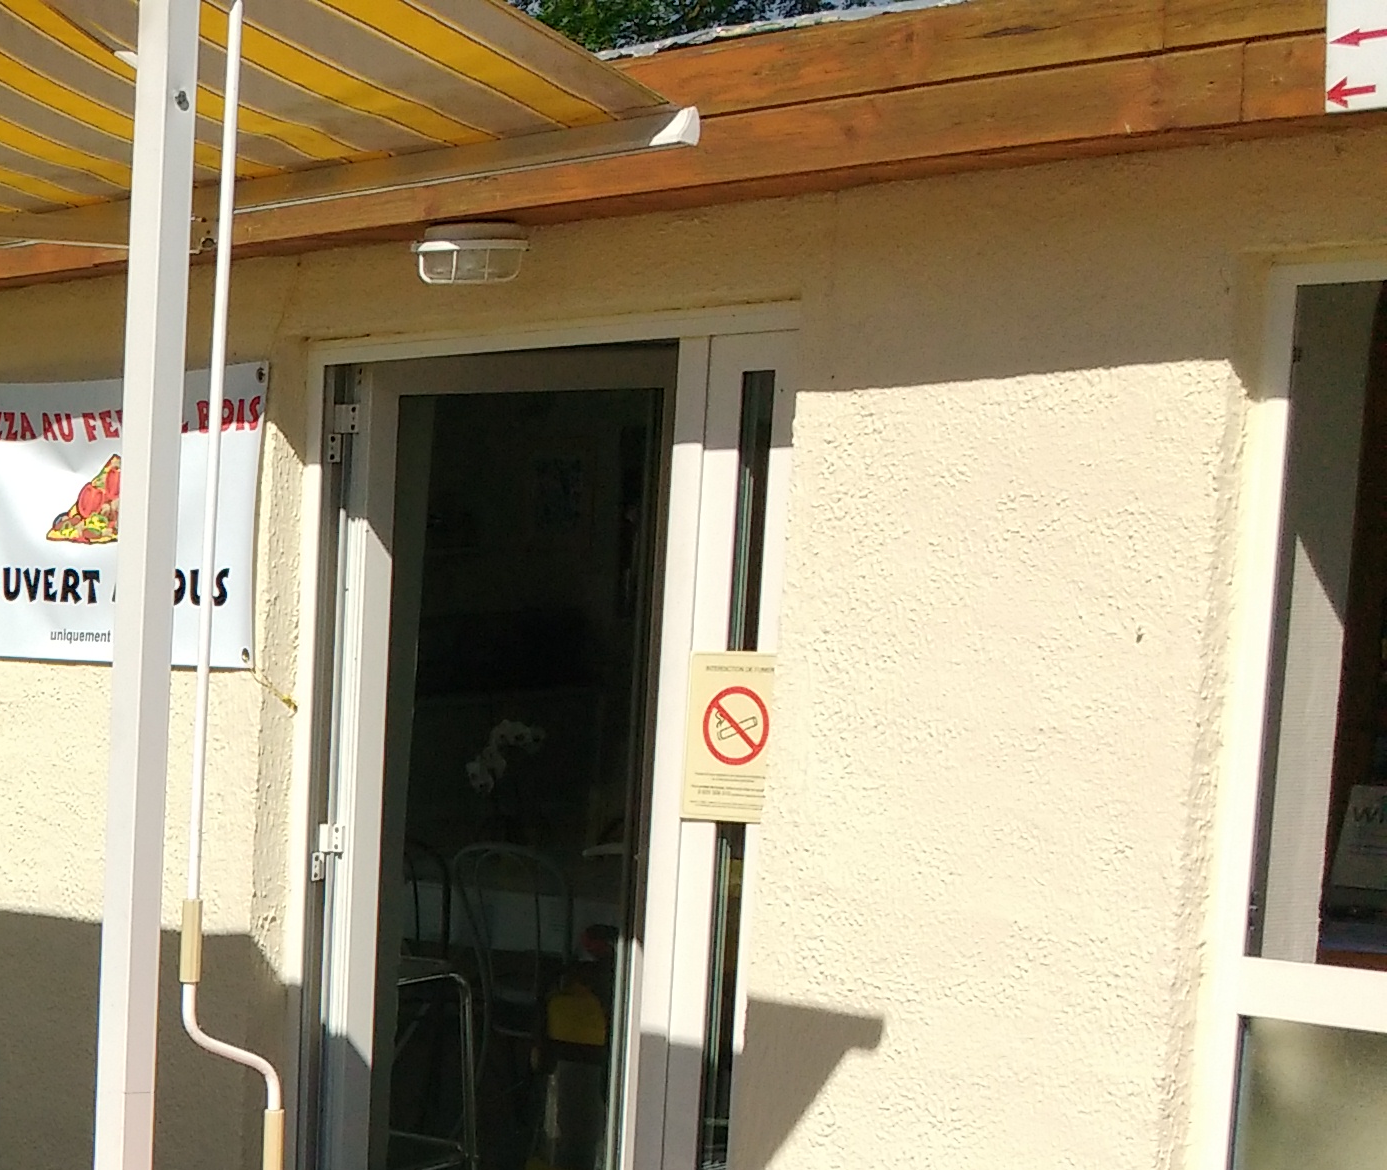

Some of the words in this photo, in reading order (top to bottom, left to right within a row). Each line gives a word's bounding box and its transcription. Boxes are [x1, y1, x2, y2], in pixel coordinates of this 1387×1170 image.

[42, 412, 74, 442] AU
[196, 396, 261, 433] BOIS
[173, 567, 230, 607] OUS
[49, 628, 111, 644] uniquement
